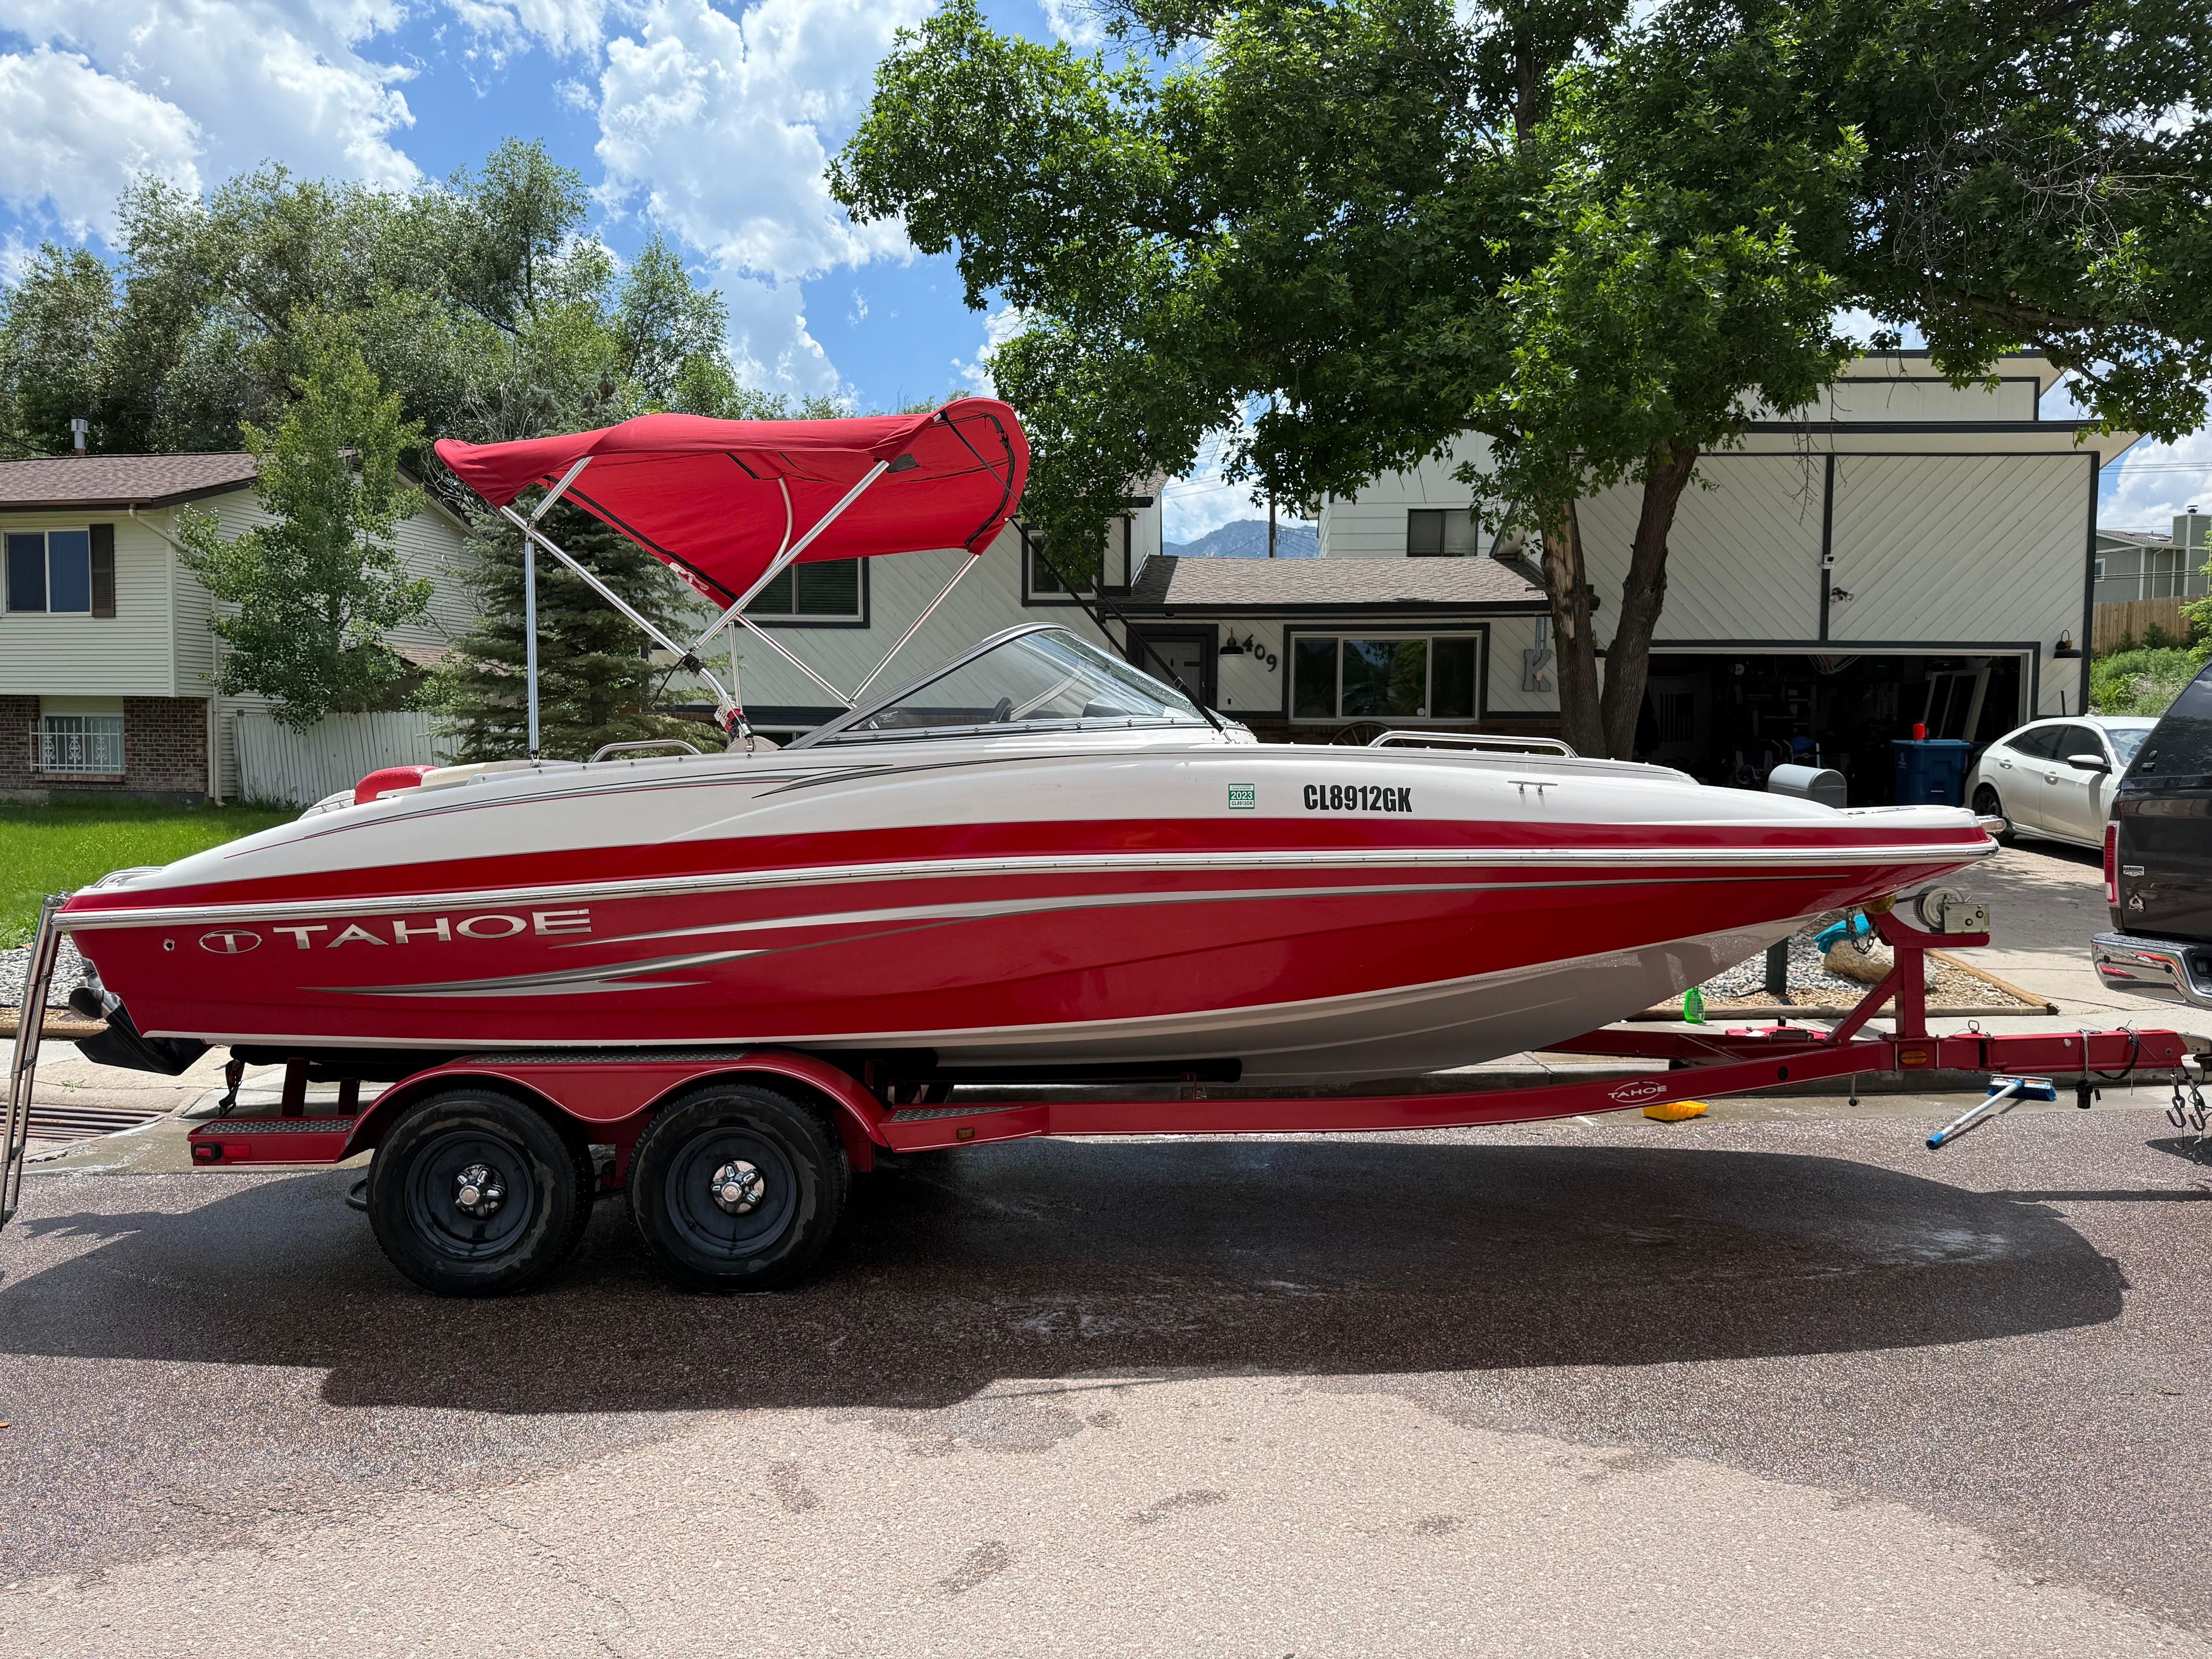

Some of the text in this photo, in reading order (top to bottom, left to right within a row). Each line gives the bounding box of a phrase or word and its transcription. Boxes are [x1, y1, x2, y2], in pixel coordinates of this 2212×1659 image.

[1243, 634, 1277, 672] 409
[1230, 791, 1253, 800] 2023
[1303, 784, 1412, 812] CL8912GK
[273, 908, 592, 949] TAHOE
[1607, 1085, 1667, 1099] TAHOE
